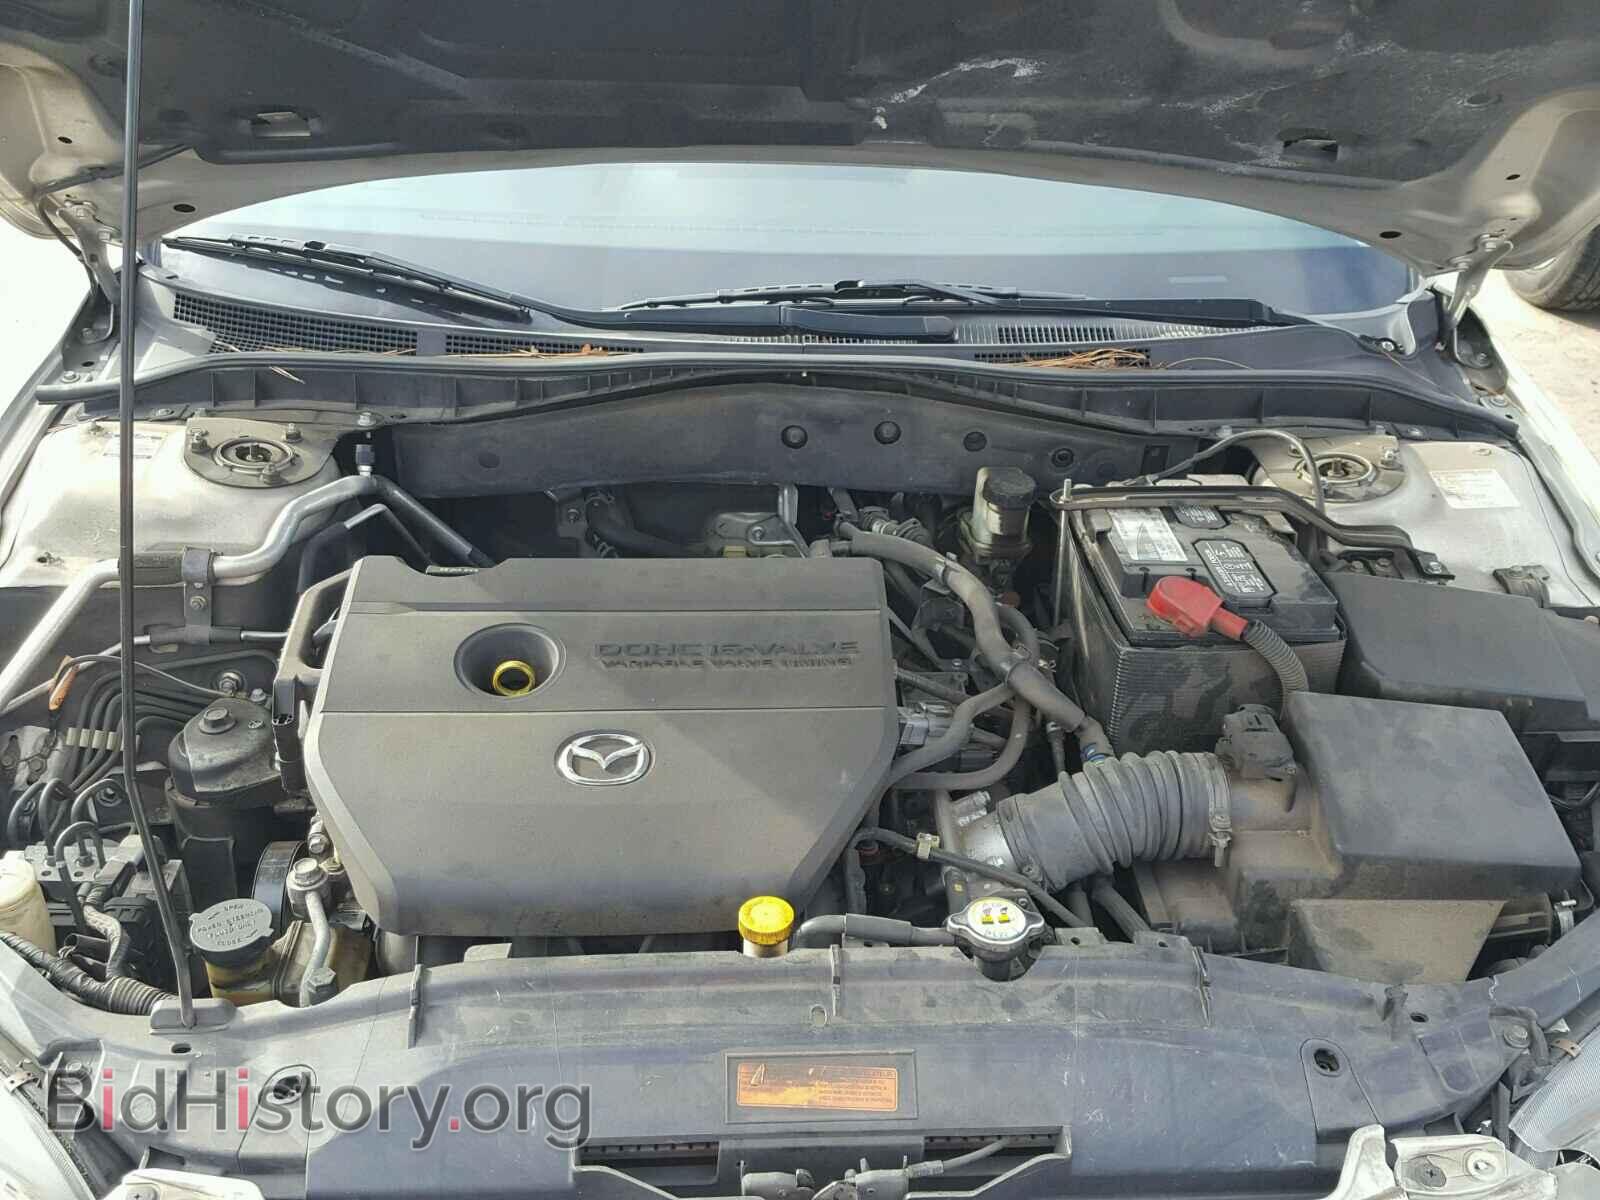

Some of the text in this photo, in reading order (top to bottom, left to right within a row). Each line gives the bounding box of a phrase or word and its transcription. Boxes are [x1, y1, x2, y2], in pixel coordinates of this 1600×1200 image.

[596, 643, 705, 657] DOHC
[600, 657, 705, 669] VARIABLE
[708, 657, 775, 669] VALVE
